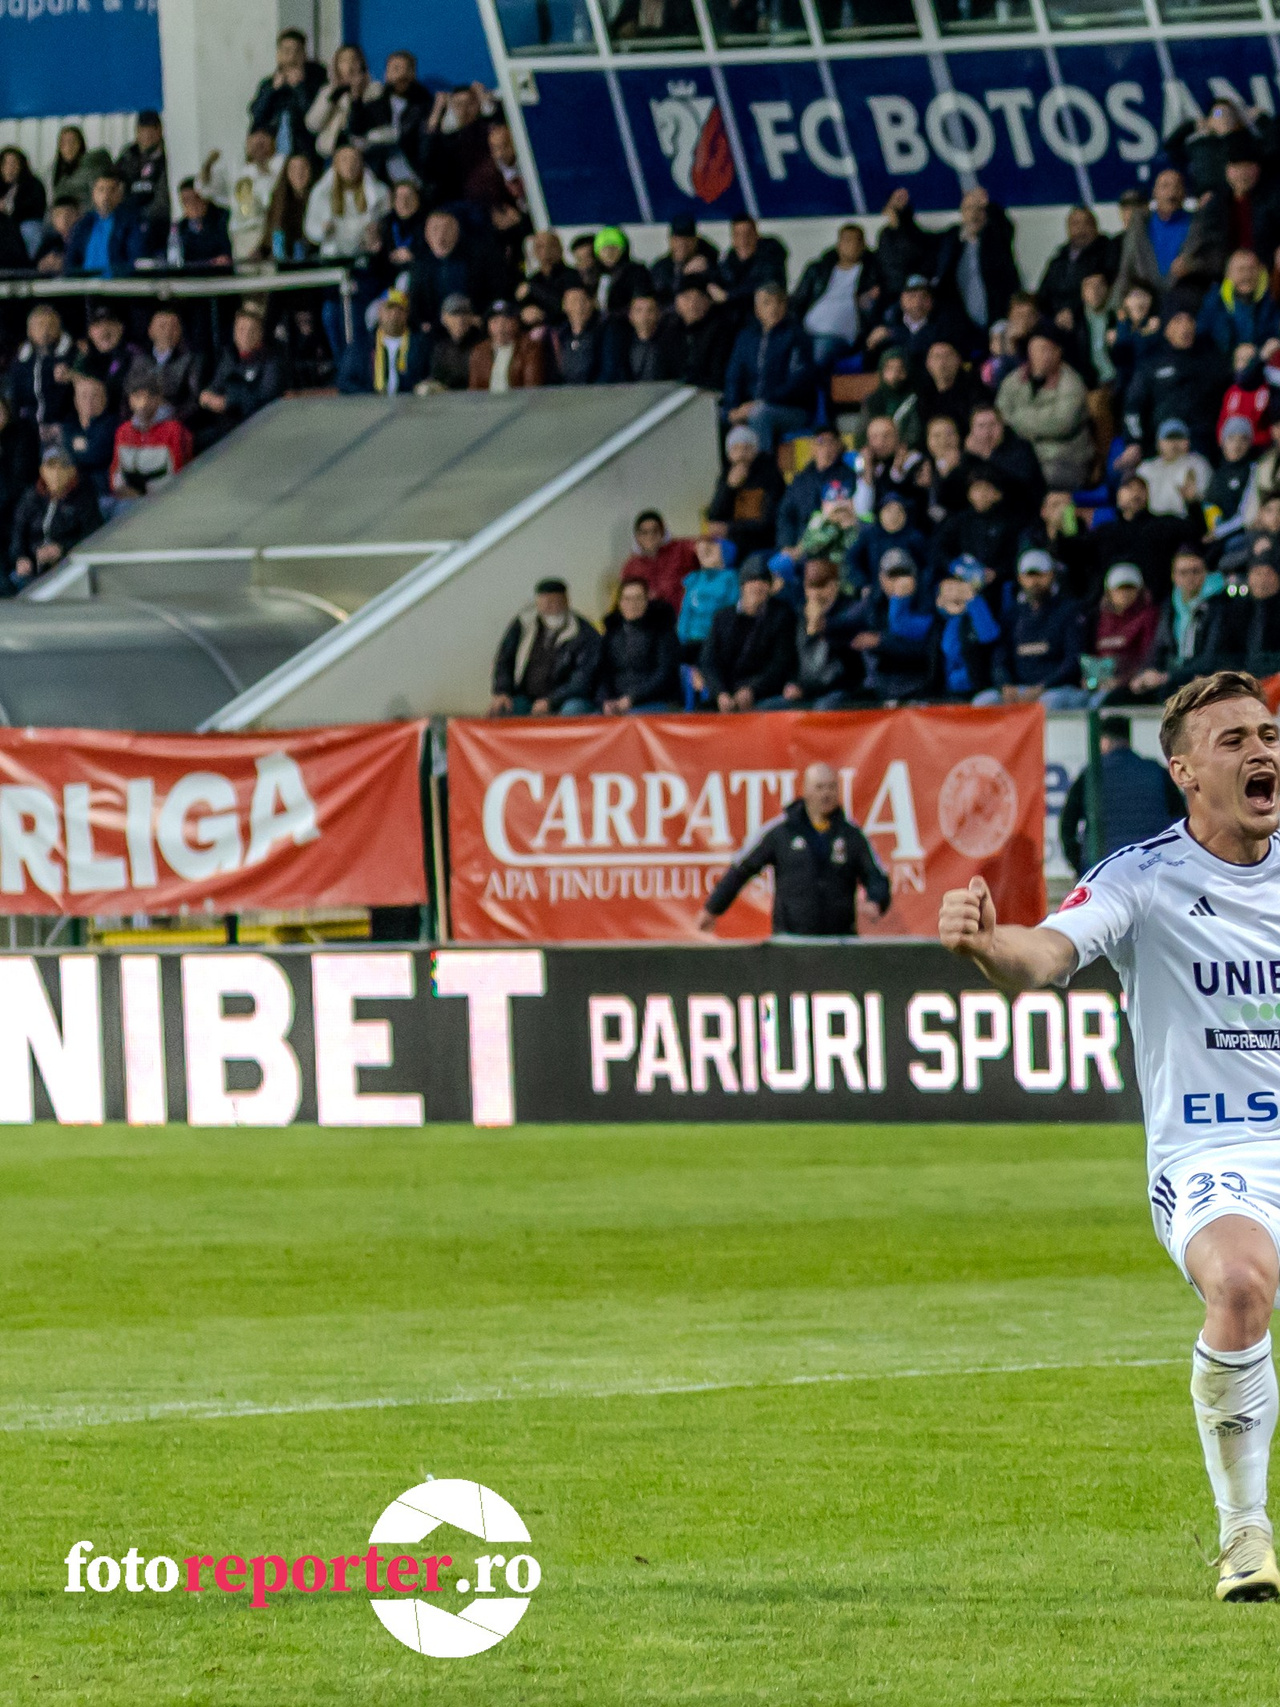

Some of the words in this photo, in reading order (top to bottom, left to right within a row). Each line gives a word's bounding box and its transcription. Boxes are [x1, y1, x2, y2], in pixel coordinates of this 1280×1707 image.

[750, 97, 858, 181] FC
[0, 751, 320, 894] RLIGA
[484, 870, 538, 900] APA
[0, 951, 547, 1127] NIBET
[588, 991, 886, 1093] PARIURI
[907, 990, 1129, 1093] SPOR
